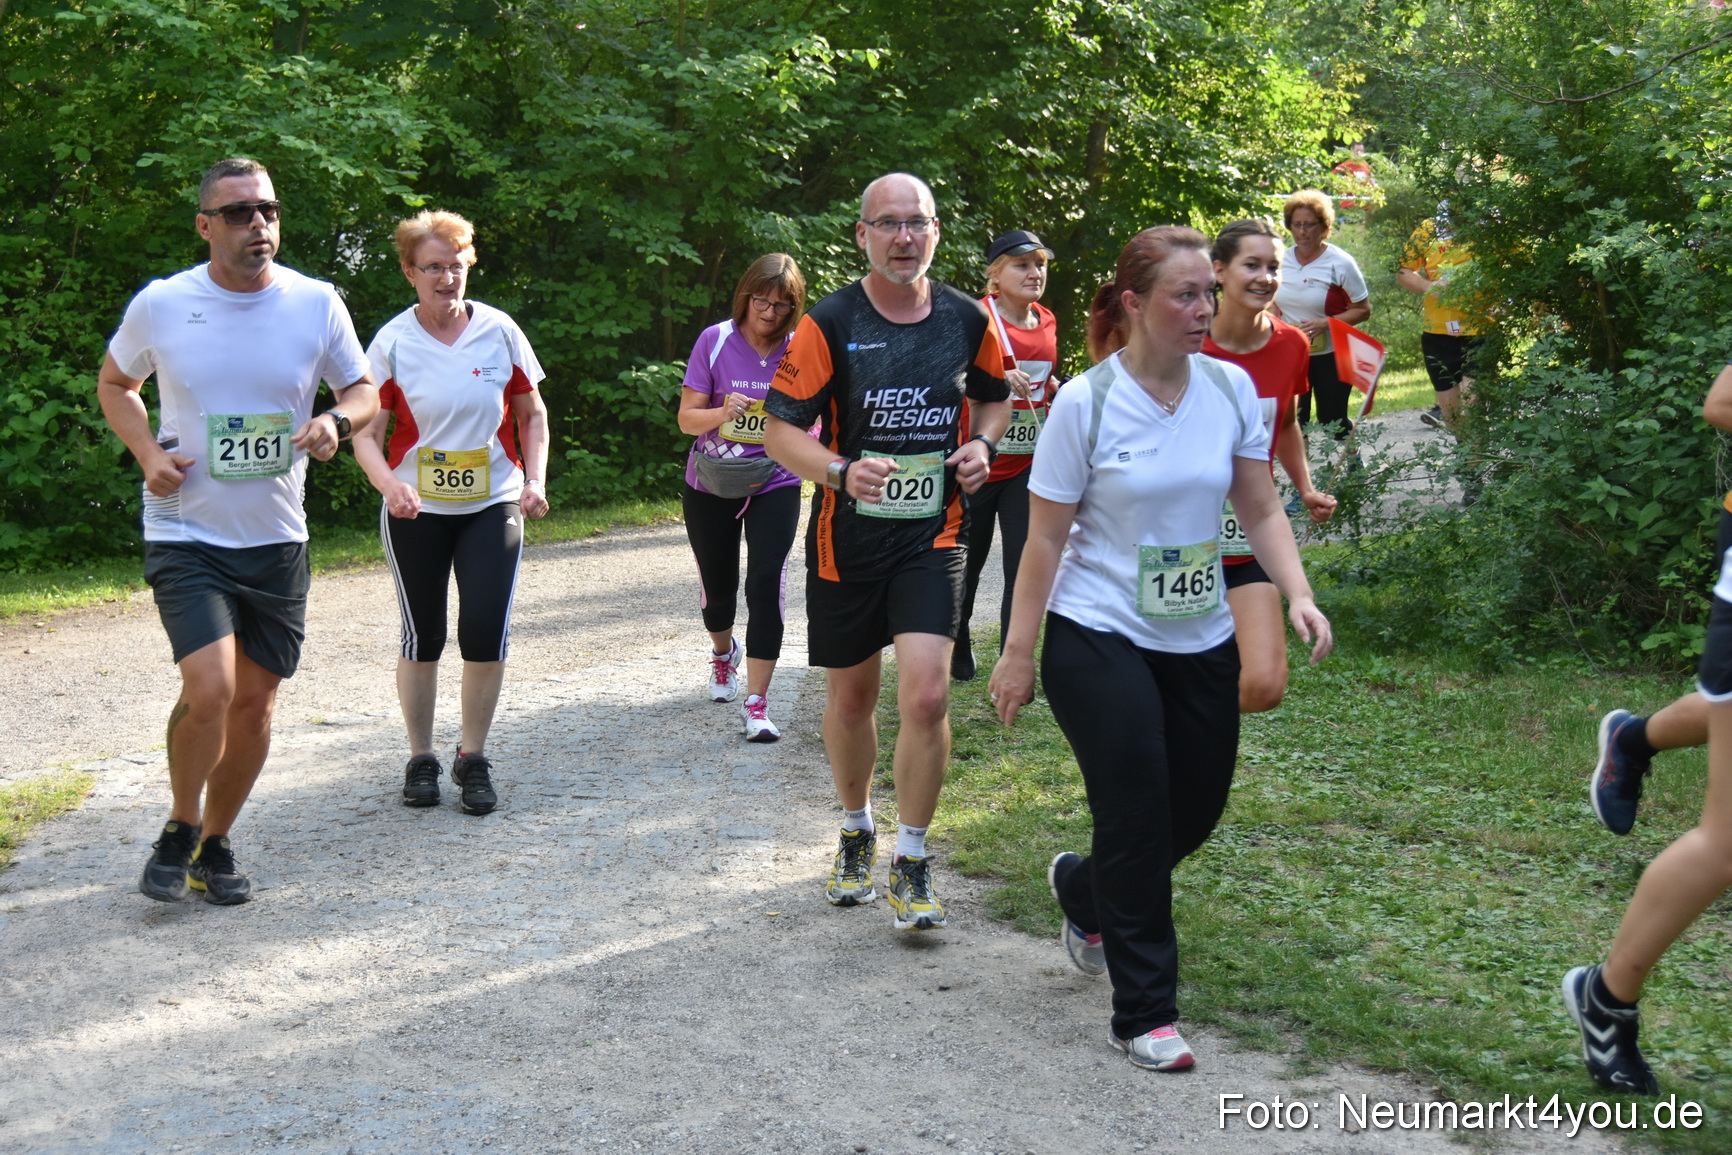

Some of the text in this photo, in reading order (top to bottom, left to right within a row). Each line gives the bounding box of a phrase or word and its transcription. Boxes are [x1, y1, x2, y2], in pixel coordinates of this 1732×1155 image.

[732, 380, 749, 389] WIR
[863, 387, 931, 409] HECK
[869, 406, 958, 429] DESIGN
[220, 436, 281, 461] 2161
[252, 459, 278, 467] Stephan
[433, 468, 475, 488] 366
[886, 477, 934, 501] 020
[819, 487, 833, 568] www.heck-desig
[1152, 565, 1215, 598] 1465
